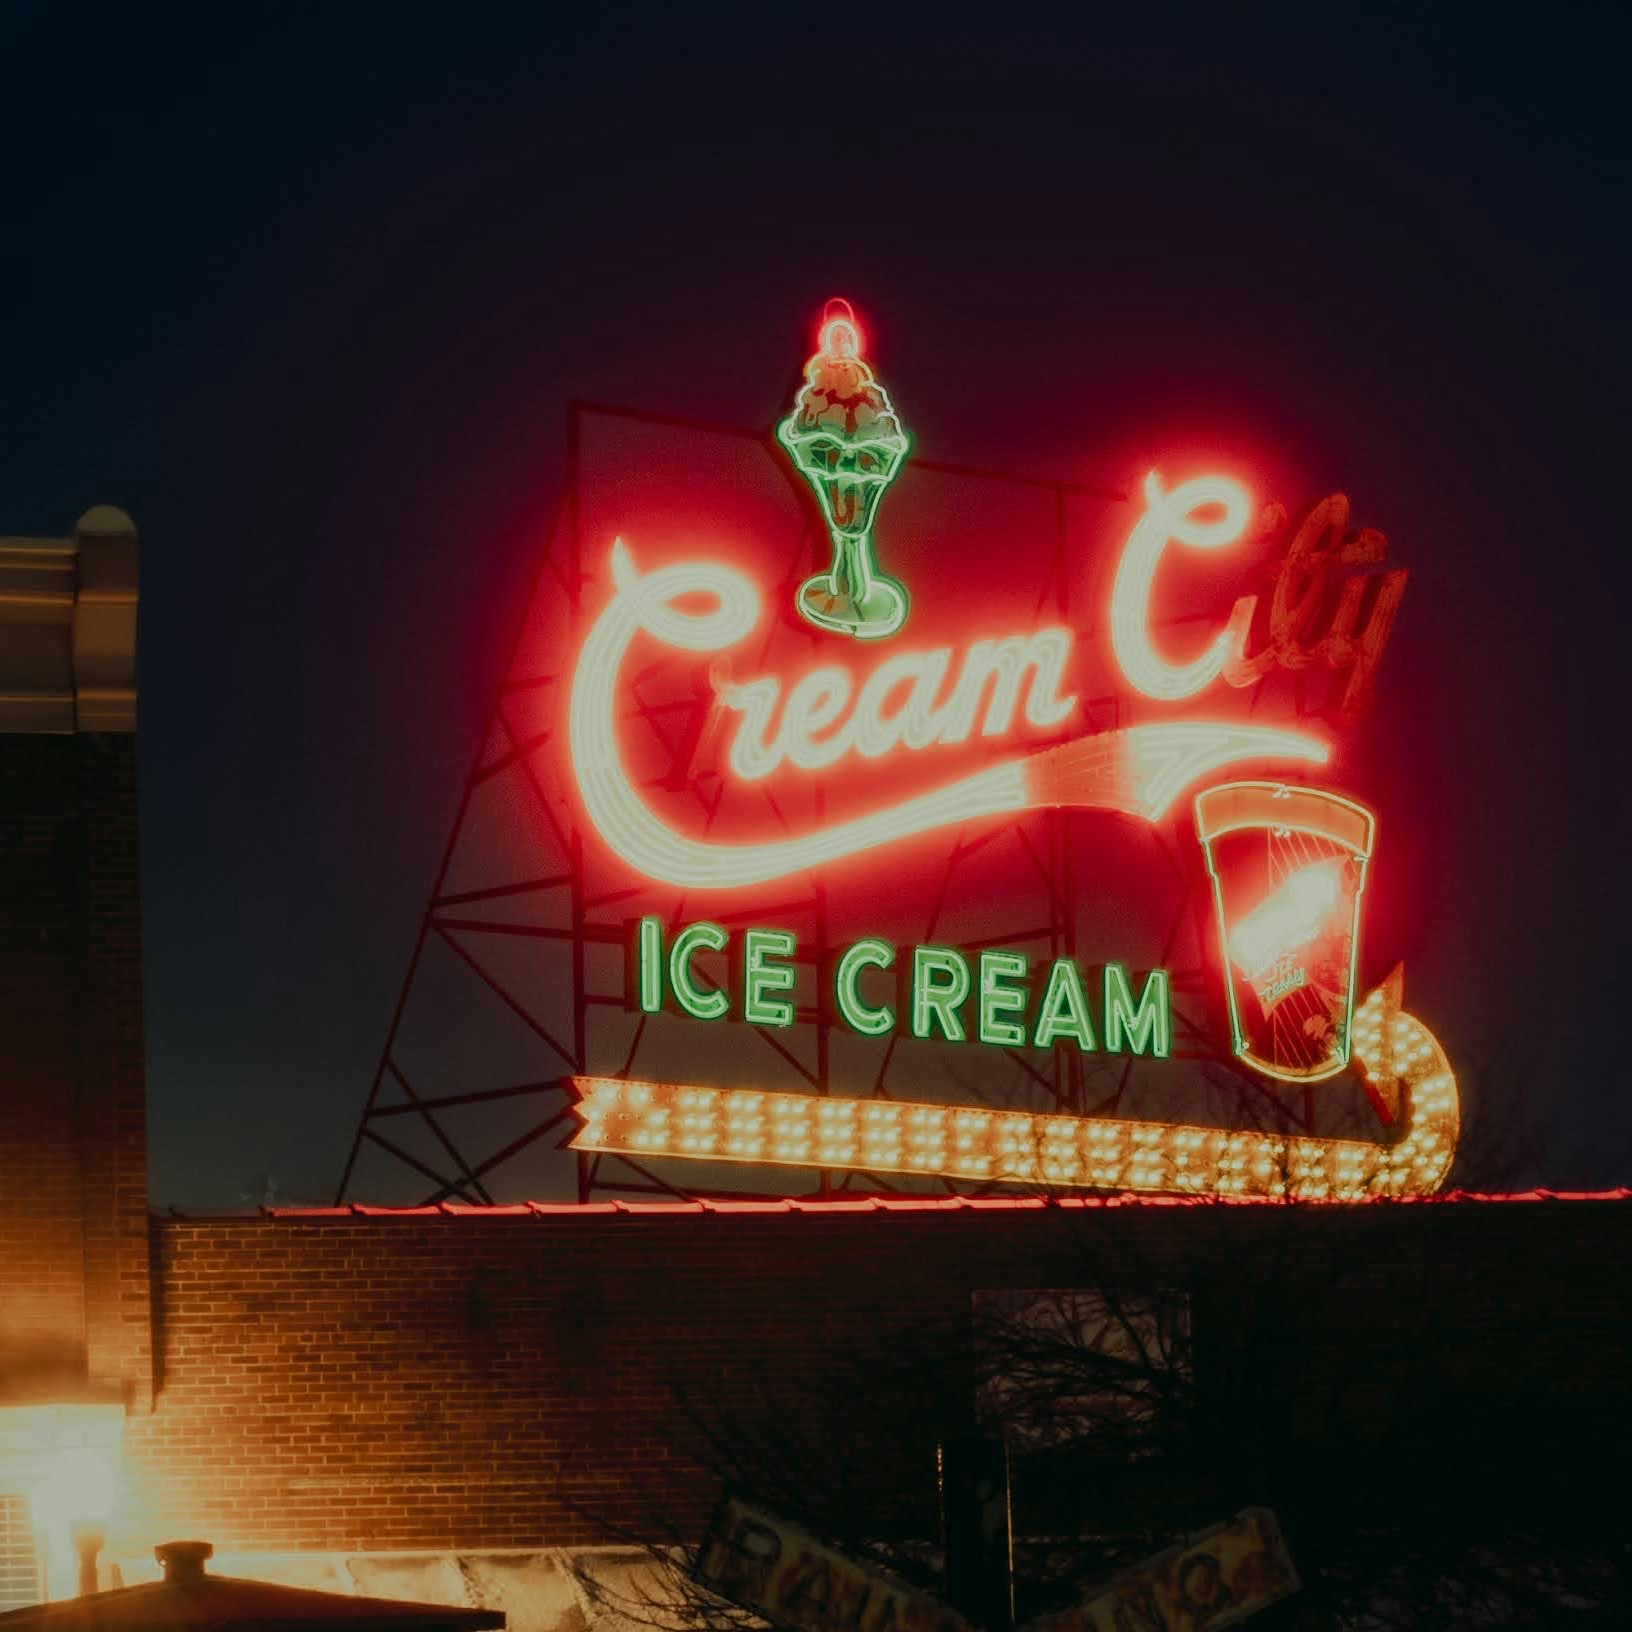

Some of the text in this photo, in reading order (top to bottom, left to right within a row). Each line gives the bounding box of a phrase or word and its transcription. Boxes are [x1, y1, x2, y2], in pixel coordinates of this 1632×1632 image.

[570, 467, 1409, 888] Cream City
[637, 915, 1170, 1057] ICE CREAM
